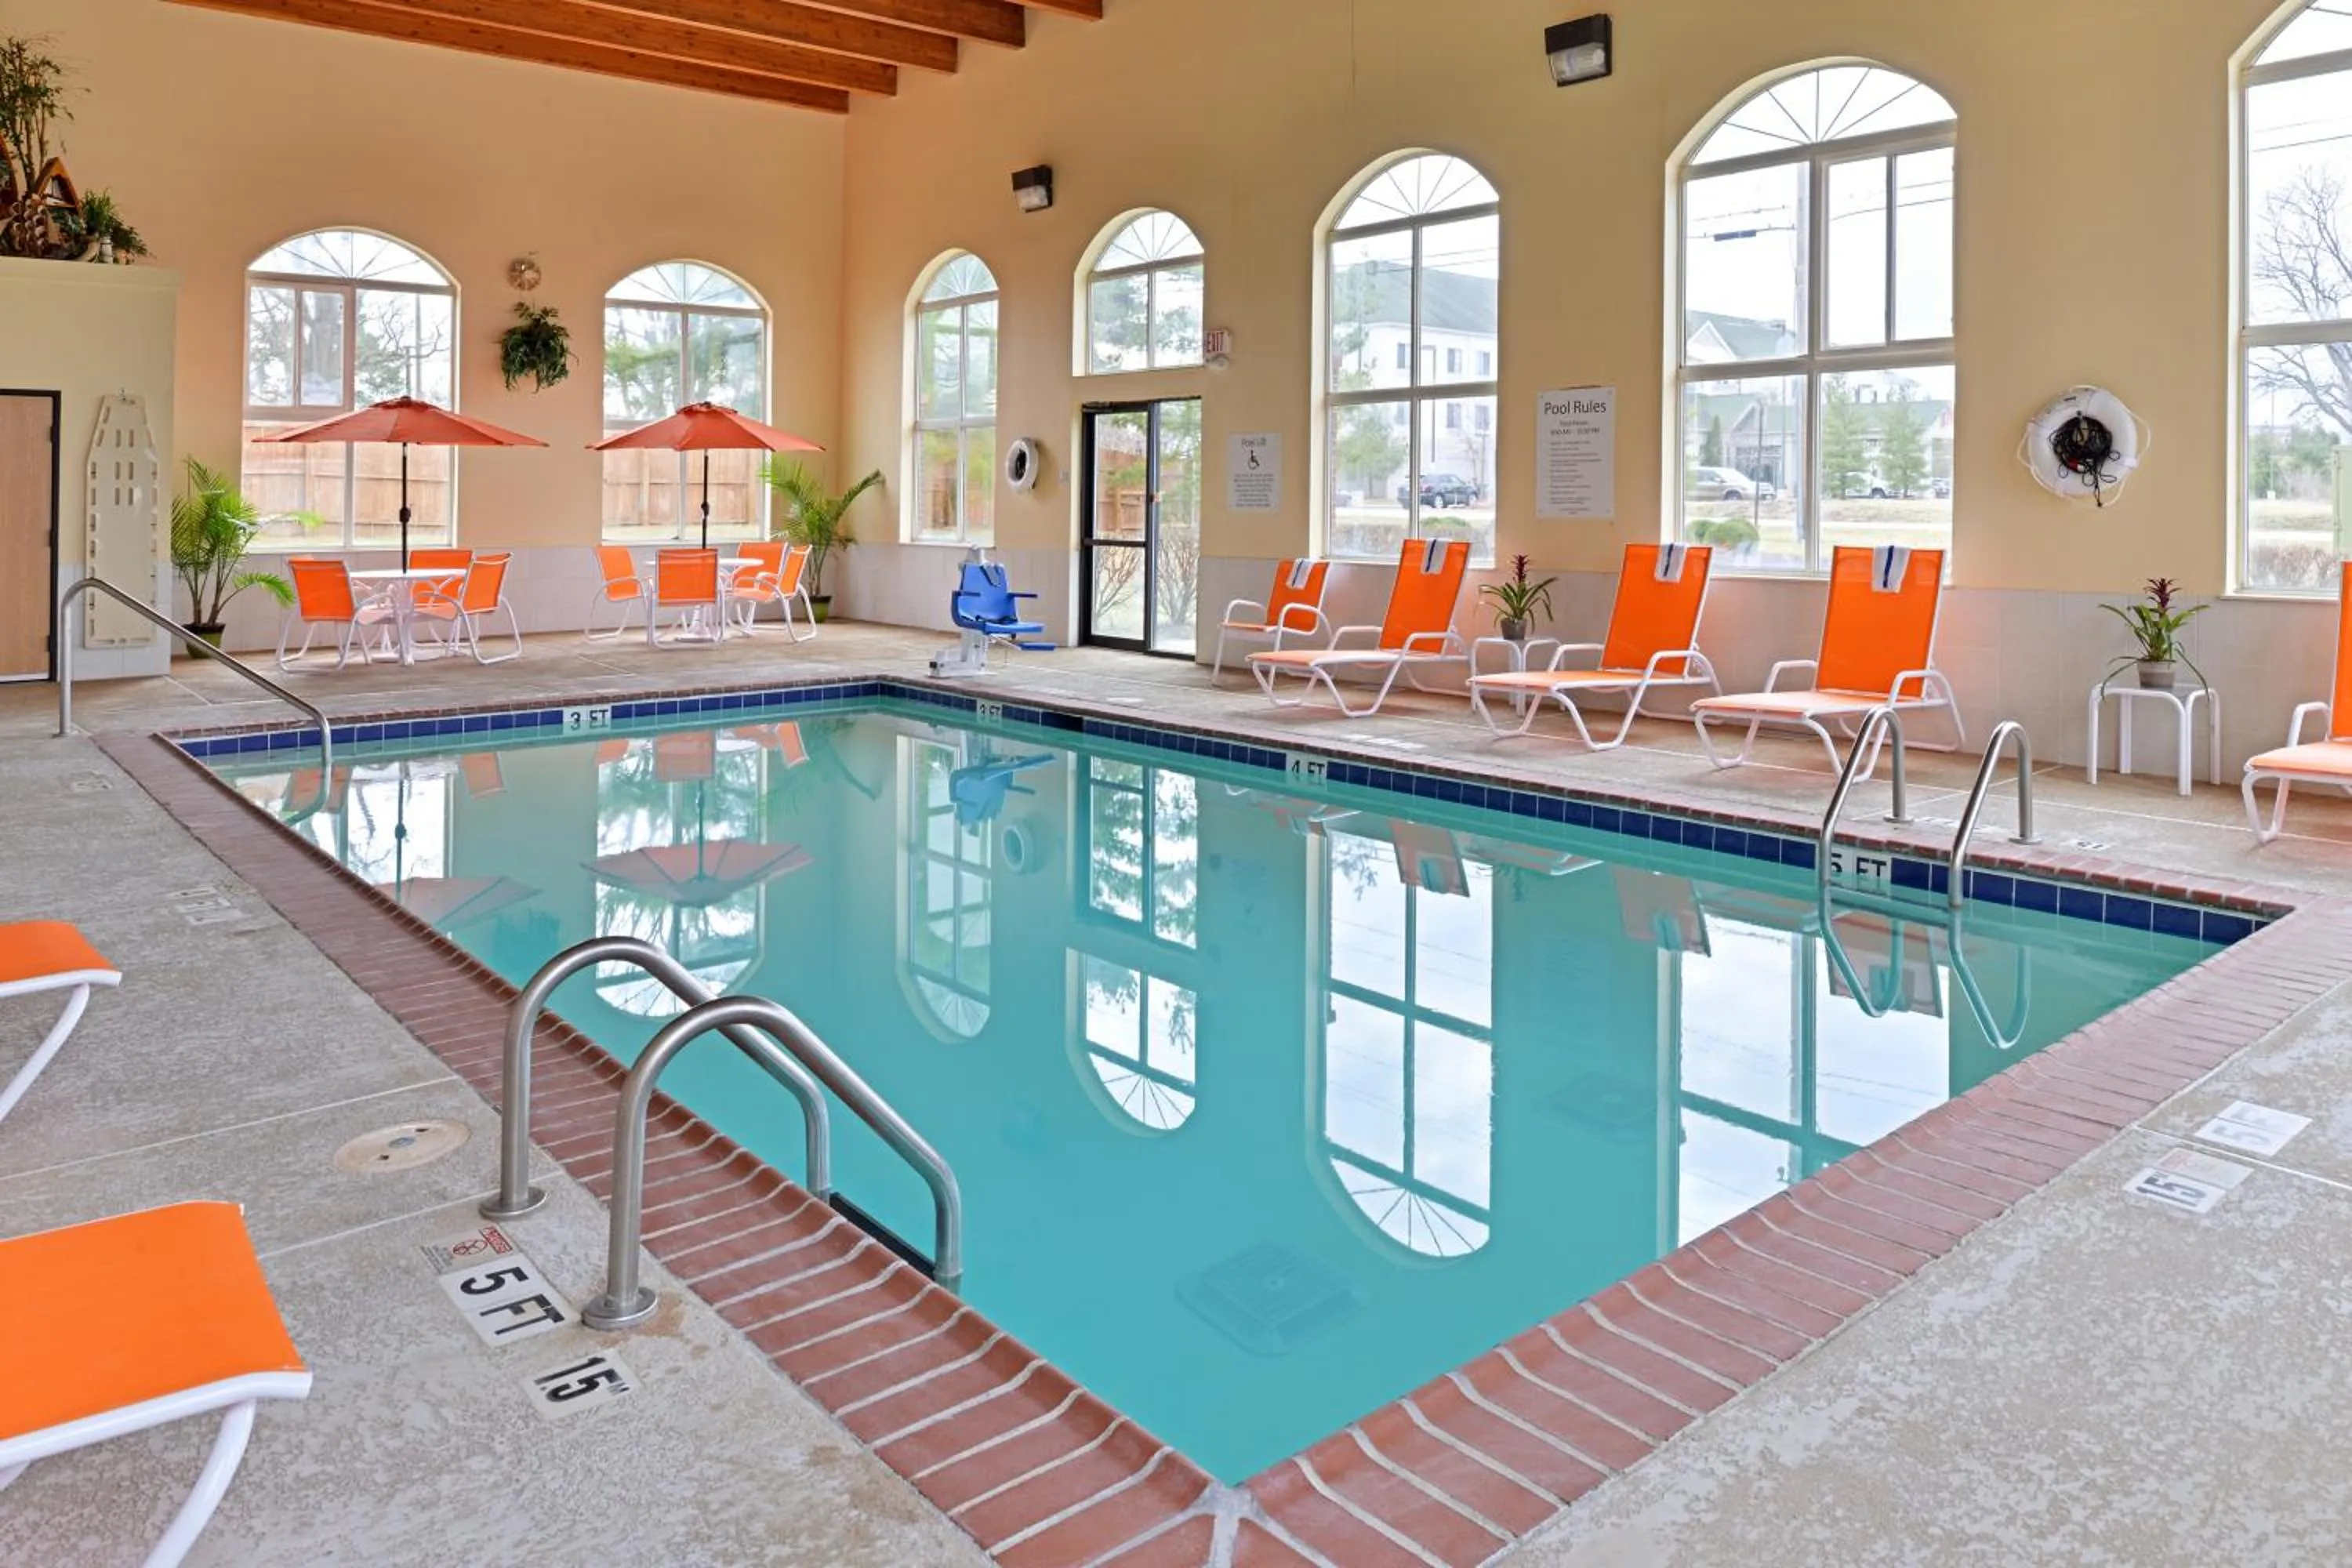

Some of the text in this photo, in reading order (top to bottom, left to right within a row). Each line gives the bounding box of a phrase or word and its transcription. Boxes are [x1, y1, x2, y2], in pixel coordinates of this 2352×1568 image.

[1207, 331, 1224, 352] EXIT
[1544, 400, 1606, 415] Pool Rules
[570, 709, 608, 722] 3 FT
[1308, 761, 1325, 775] FT
[1856, 856, 1886, 877] FT
[460, 1266, 528, 1294] 5
[479, 1294, 565, 1335] FT
